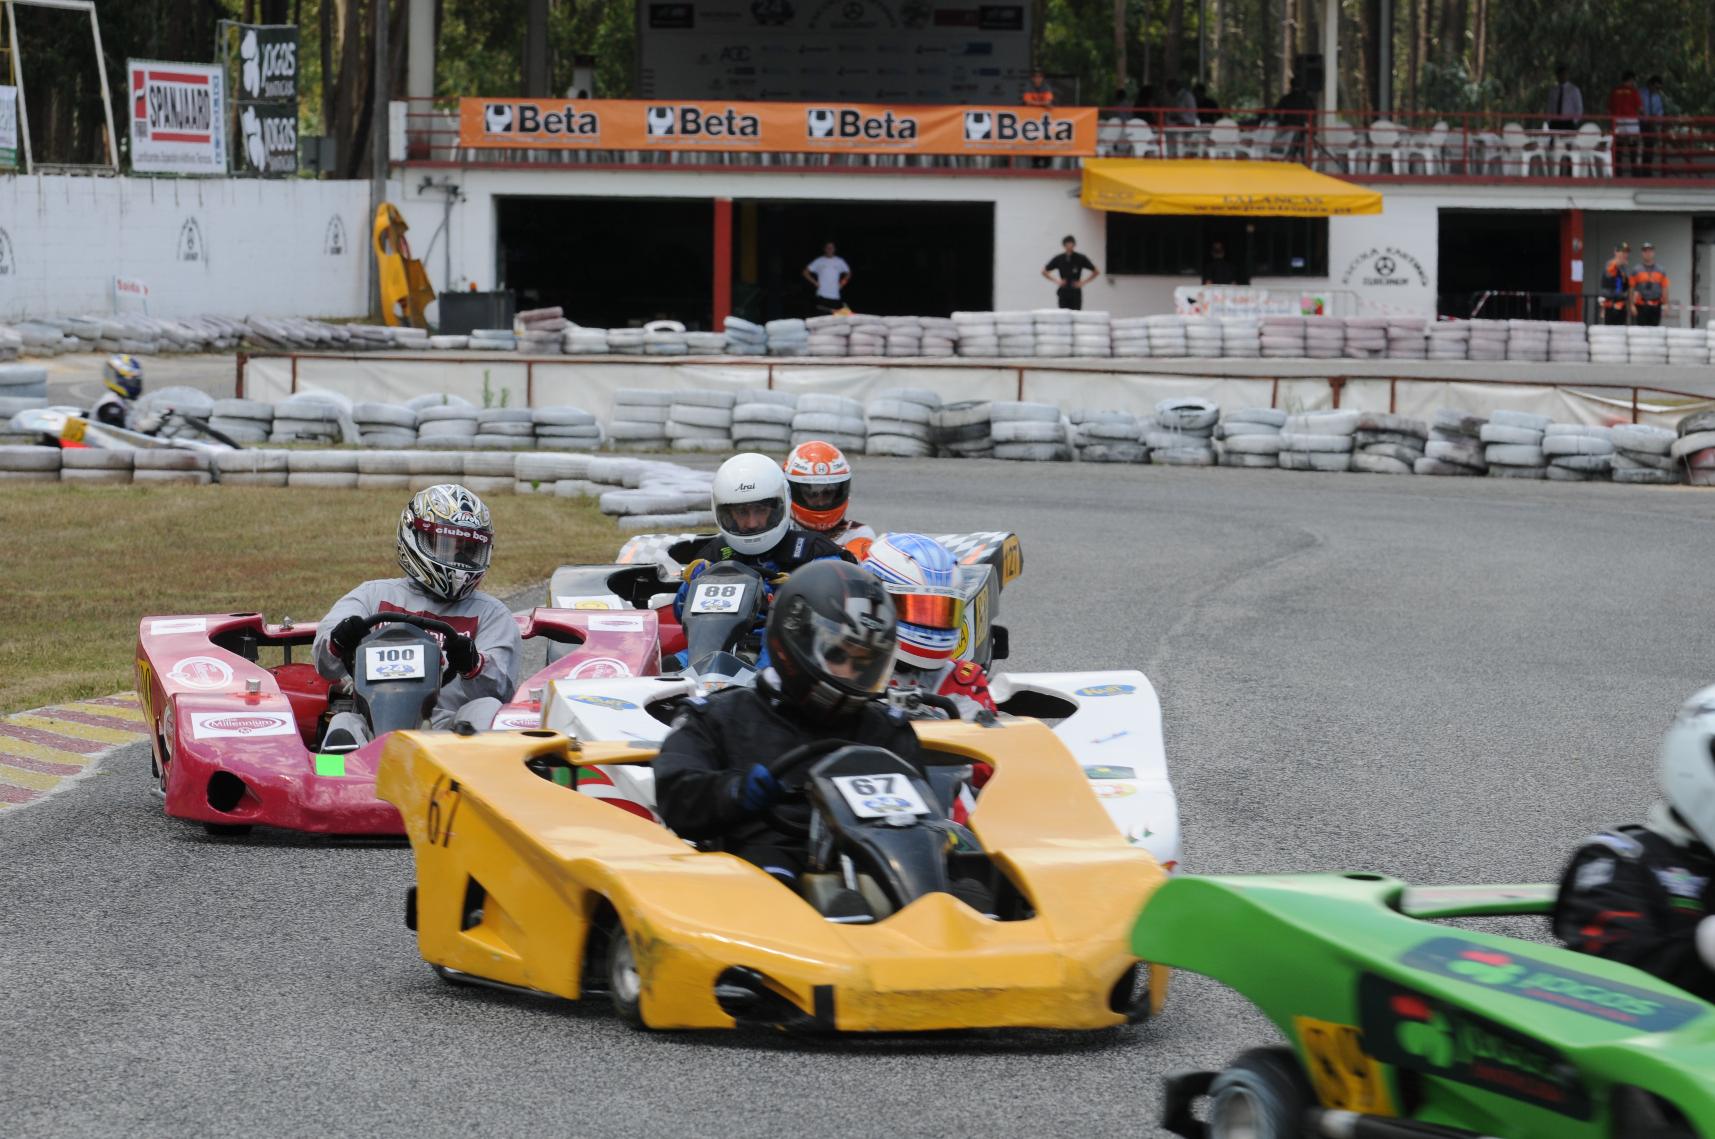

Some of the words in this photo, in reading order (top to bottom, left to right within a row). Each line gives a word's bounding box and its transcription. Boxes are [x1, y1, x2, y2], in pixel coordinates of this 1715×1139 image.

[149, 84, 211, 131] SPANJAARD
[518, 105, 598, 134] Beta
[680, 108, 760, 137] Beta
[840, 110, 917, 139] Beta
[997, 112, 1074, 141] Beta
[735, 483, 756, 492] Arai
[435, 527, 472, 538] clube
[472, 531, 489, 543] bcp
[704, 585, 737, 598] 88
[375, 648, 415, 662] 100
[210, 717, 274, 729] Millennium
[850, 776, 896, 796] 67
[427, 772, 463, 848] 67
